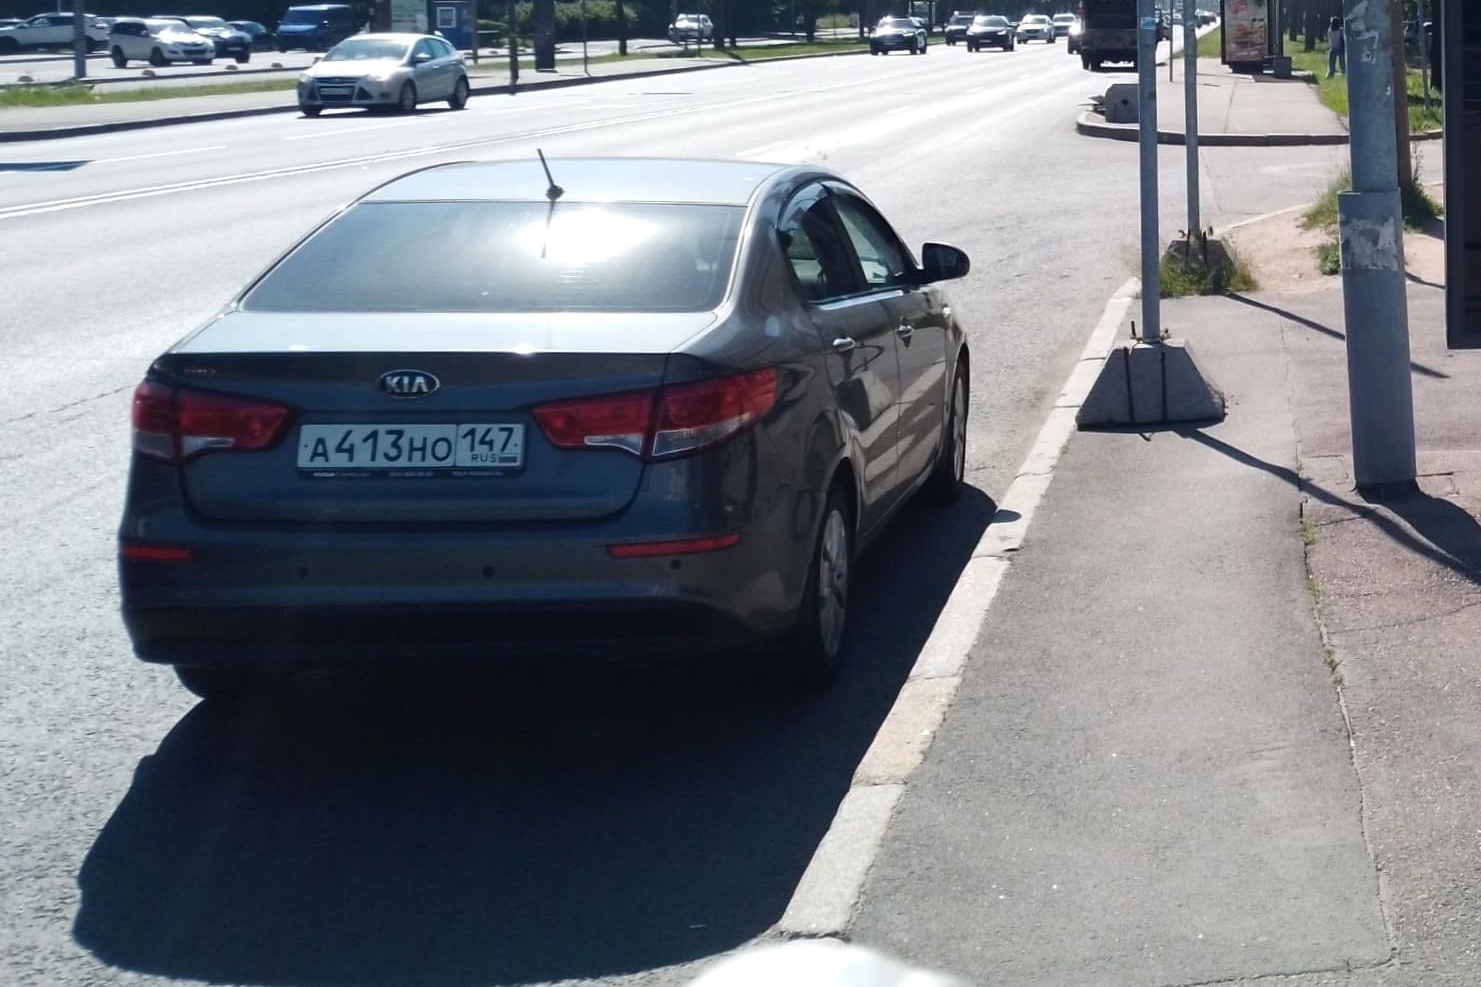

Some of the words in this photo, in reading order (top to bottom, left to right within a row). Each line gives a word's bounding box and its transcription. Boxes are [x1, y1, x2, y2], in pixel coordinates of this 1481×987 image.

[386, 375, 428, 392] KIA
[310, 429, 452, 462] А413НО
[462, 427, 514, 452] 147
[471, 453, 497, 462] RUS
